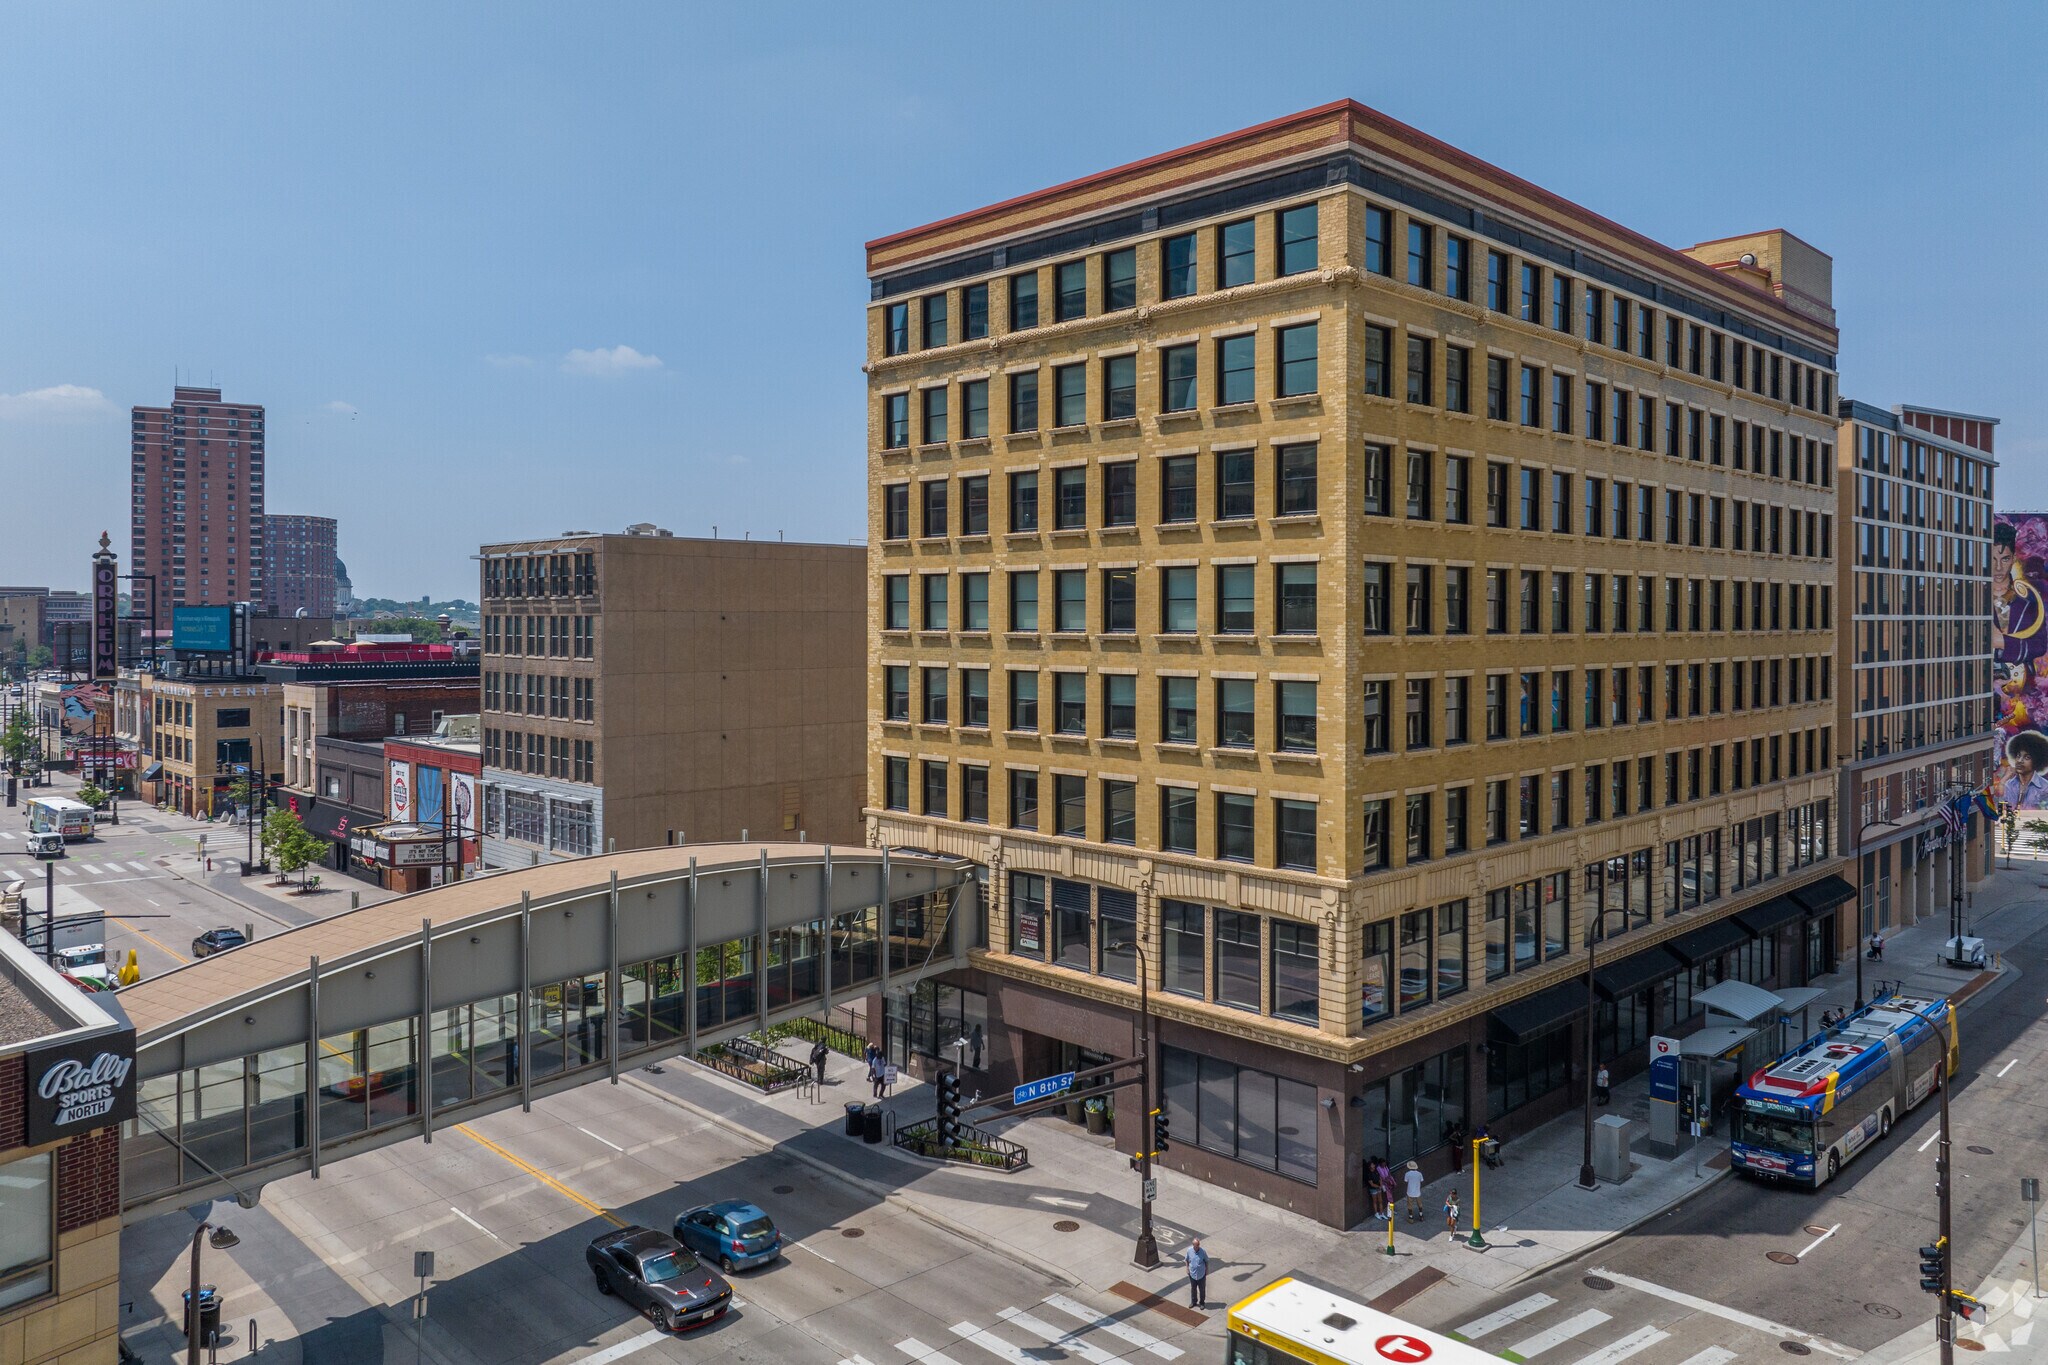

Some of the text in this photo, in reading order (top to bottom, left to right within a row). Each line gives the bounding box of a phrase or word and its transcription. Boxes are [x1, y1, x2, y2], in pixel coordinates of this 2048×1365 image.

[97, 569, 115, 671] ORPHEUM
[204, 687, 269, 697] EVENT
[37, 1052, 133, 1099] Bally
[1028, 1076, 1073, 1097] N 8th St
[59, 1084, 112, 1108] SPORTS
[68, 1101, 106, 1121] NORTH
